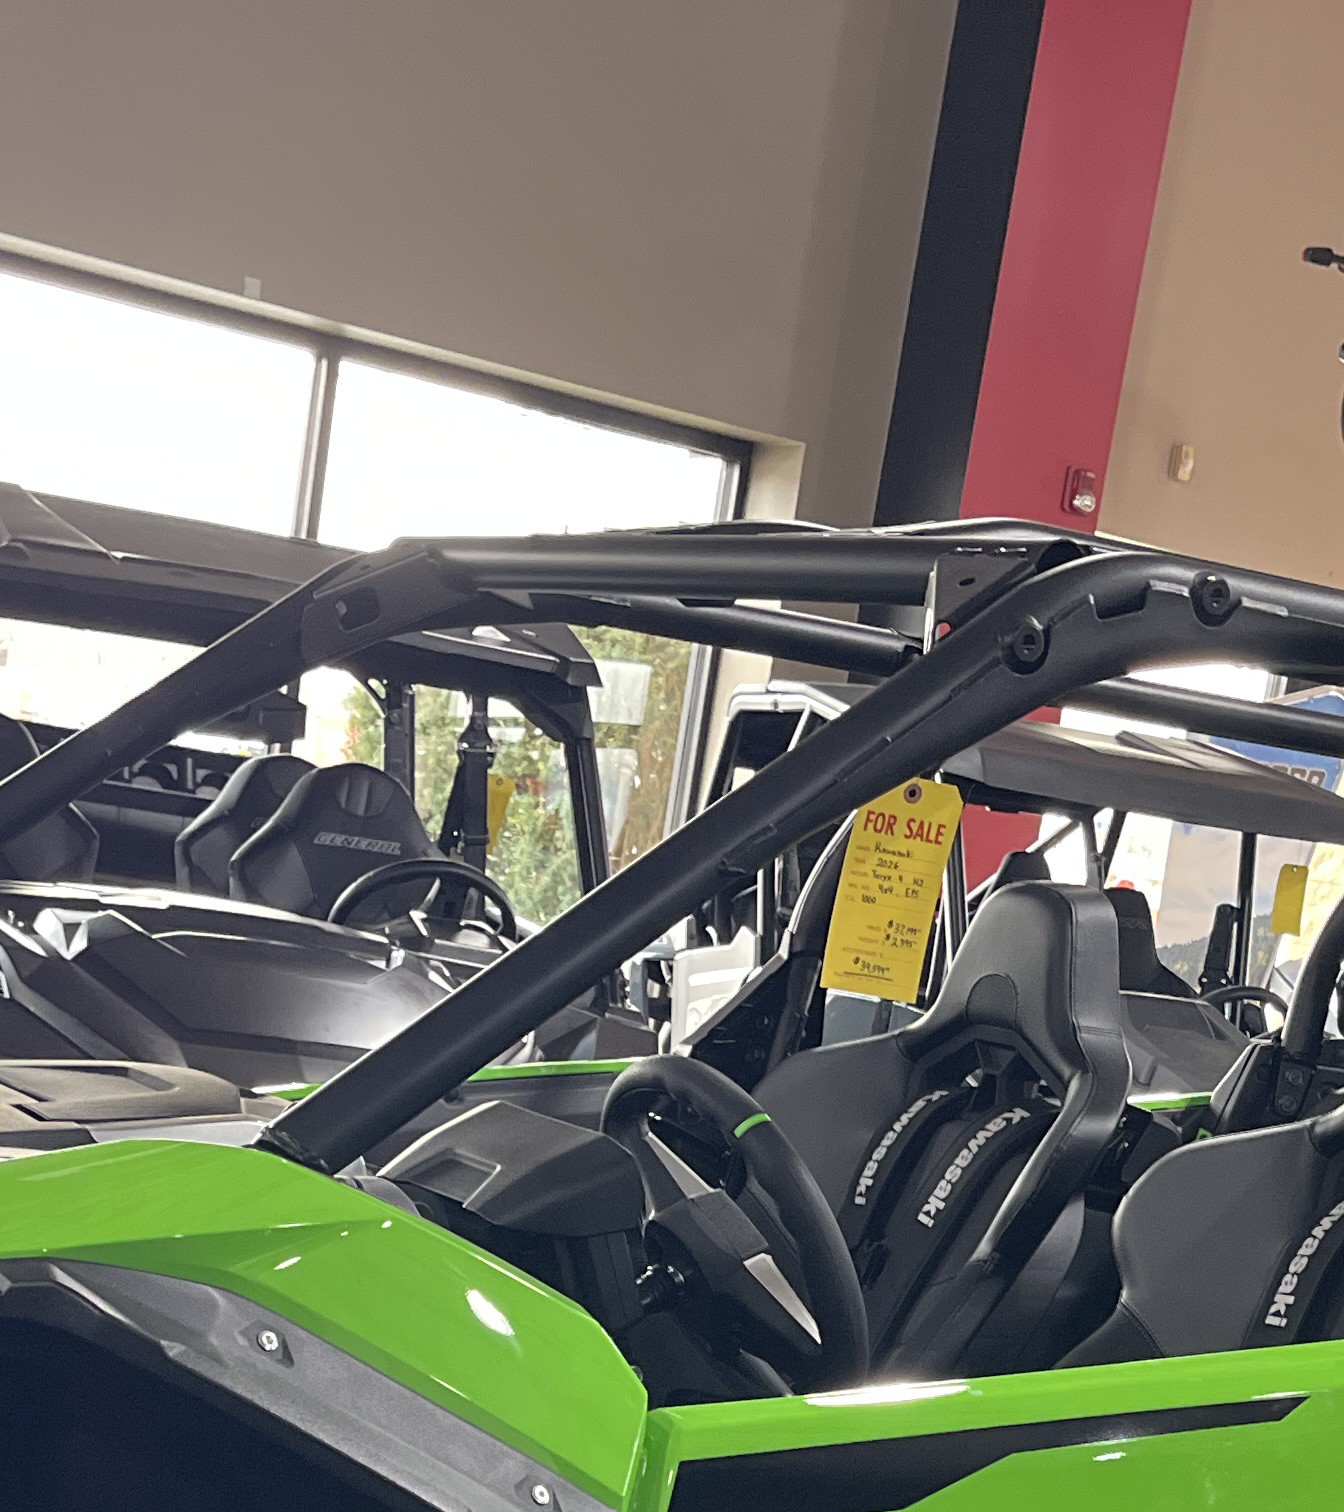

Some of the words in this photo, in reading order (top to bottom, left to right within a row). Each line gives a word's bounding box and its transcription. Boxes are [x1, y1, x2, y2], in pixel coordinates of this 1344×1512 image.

[313, 831, 401, 856] GENERAL
[863, 810, 897, 836] FOR
[904, 818, 947, 845] SALE
[854, 1089, 949, 1205] Kawasaki
[916, 1106, 1032, 1228] Kawasaki
